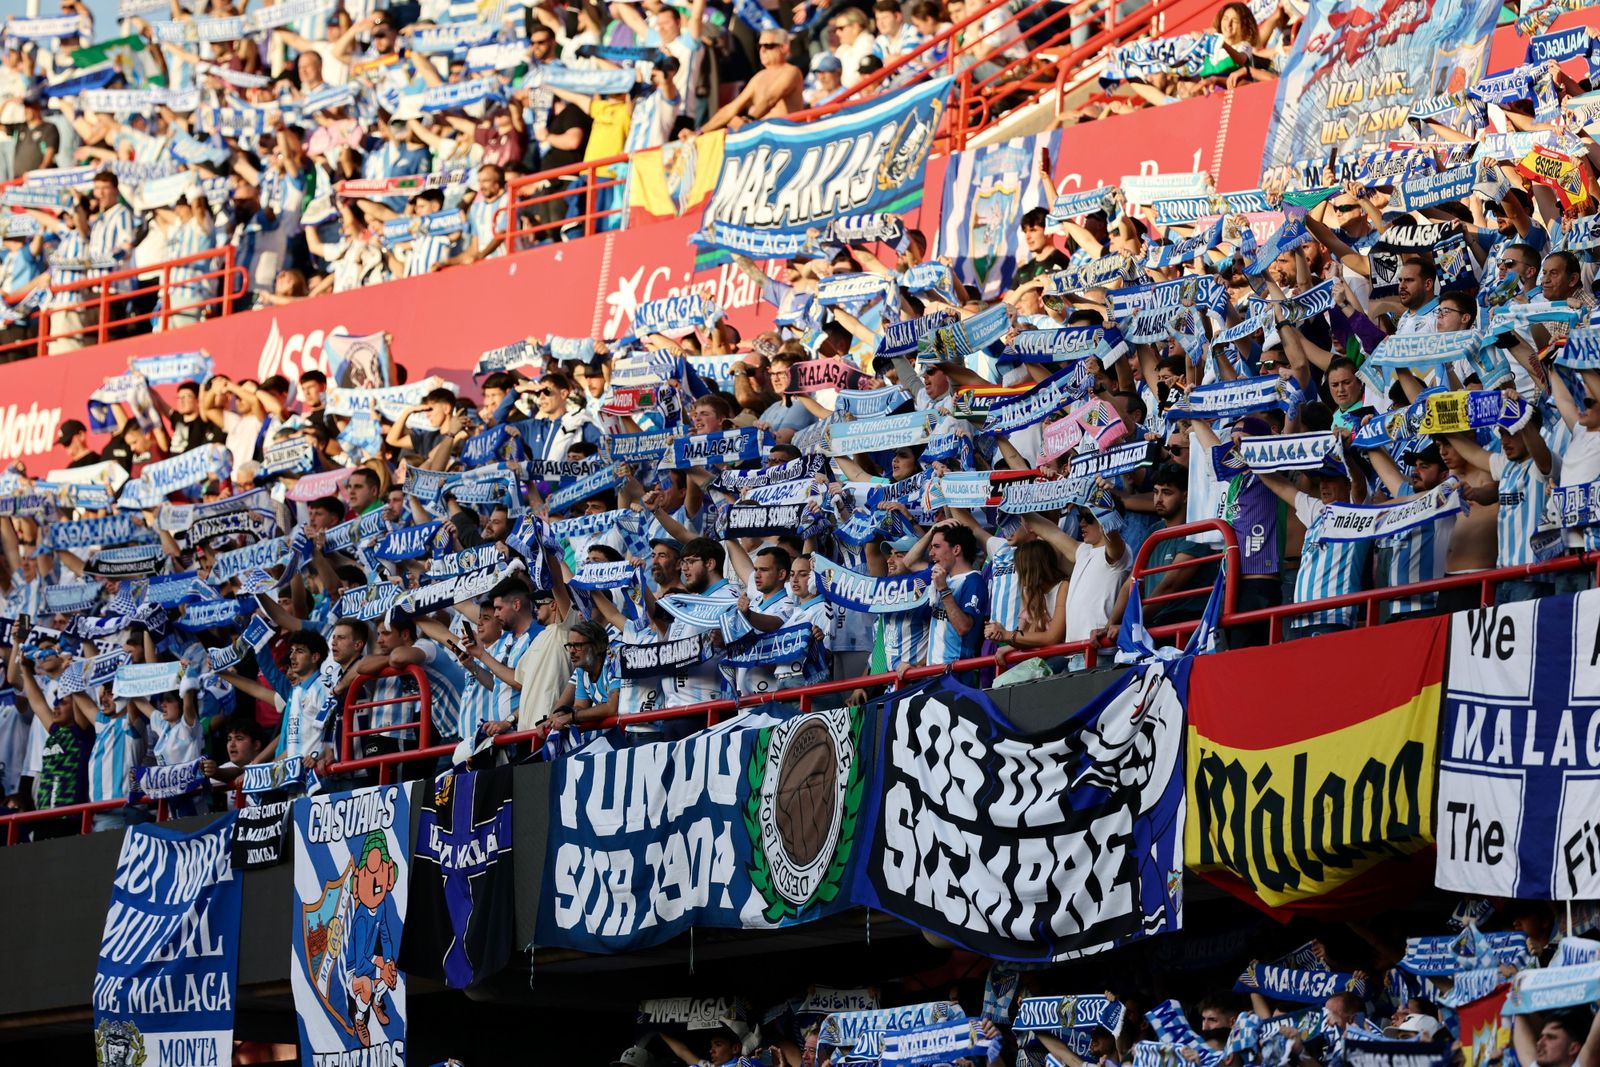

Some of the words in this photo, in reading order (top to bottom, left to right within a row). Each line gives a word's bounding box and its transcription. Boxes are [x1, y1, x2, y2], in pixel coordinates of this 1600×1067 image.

[1455, 182, 1470, 197] Sur
[1157, 197, 1210, 224] FONDO
[1226, 191, 1264, 213] SUR
[724, 230, 798, 254] MALAGA
[1381, 225, 1437, 248] MALAGA
[636, 296, 704, 327] MALAGA
[1306, 292, 1334, 317] SUR
[1019, 329, 1089, 356] MALAGA
[1223, 320, 1259, 341] MALAGA
[1383, 333, 1447, 359] MALAGA
[797, 363, 848, 391] MALAGA
[1001, 381, 1063, 422] MALAGA
[1201, 384, 1263, 412] MALAGA
[0, 402, 62, 459] Motor
[848, 413, 913, 434] SENTIMIENTOS
[841, 429, 912, 453] BLANQUIAZULES
[1243, 443, 1307, 464] MALAGA
[550, 475, 611, 509] MALAGA
[361, 513, 382, 537] SUR
[1333, 511, 1375, 533] málaga
[1251, 524, 1265, 552] Olin
[220, 545, 273, 578] MALAGA
[834, 573, 908, 606] MALAGA
[189, 600, 237, 623] MALAGA
[1467, 605, 1517, 662] We
[625, 649, 658, 671] SOMOS
[658, 637, 700, 665] GRANDES
[892, 689, 988, 823] LOS
[987, 737, 1073, 829] DE
[146, 763, 194, 791] Malaga
[308, 787, 398, 844] CASUALS
[762, 792, 778, 853] 1904
[1446, 800, 1505, 866] The
[882, 780, 1134, 941] SIEMPRE
[555, 842, 637, 937] SUR
[772, 857, 810, 898] DESDE
[92, 972, 122, 1014] DE
[127, 967, 232, 1014] MÁLAGA
[1263, 966, 1338, 999] MALAGA
[650, 997, 728, 1025] MALAGA
[160, 1037, 218, 1067] MONTA
[896, 1029, 958, 1056] MALAGA
